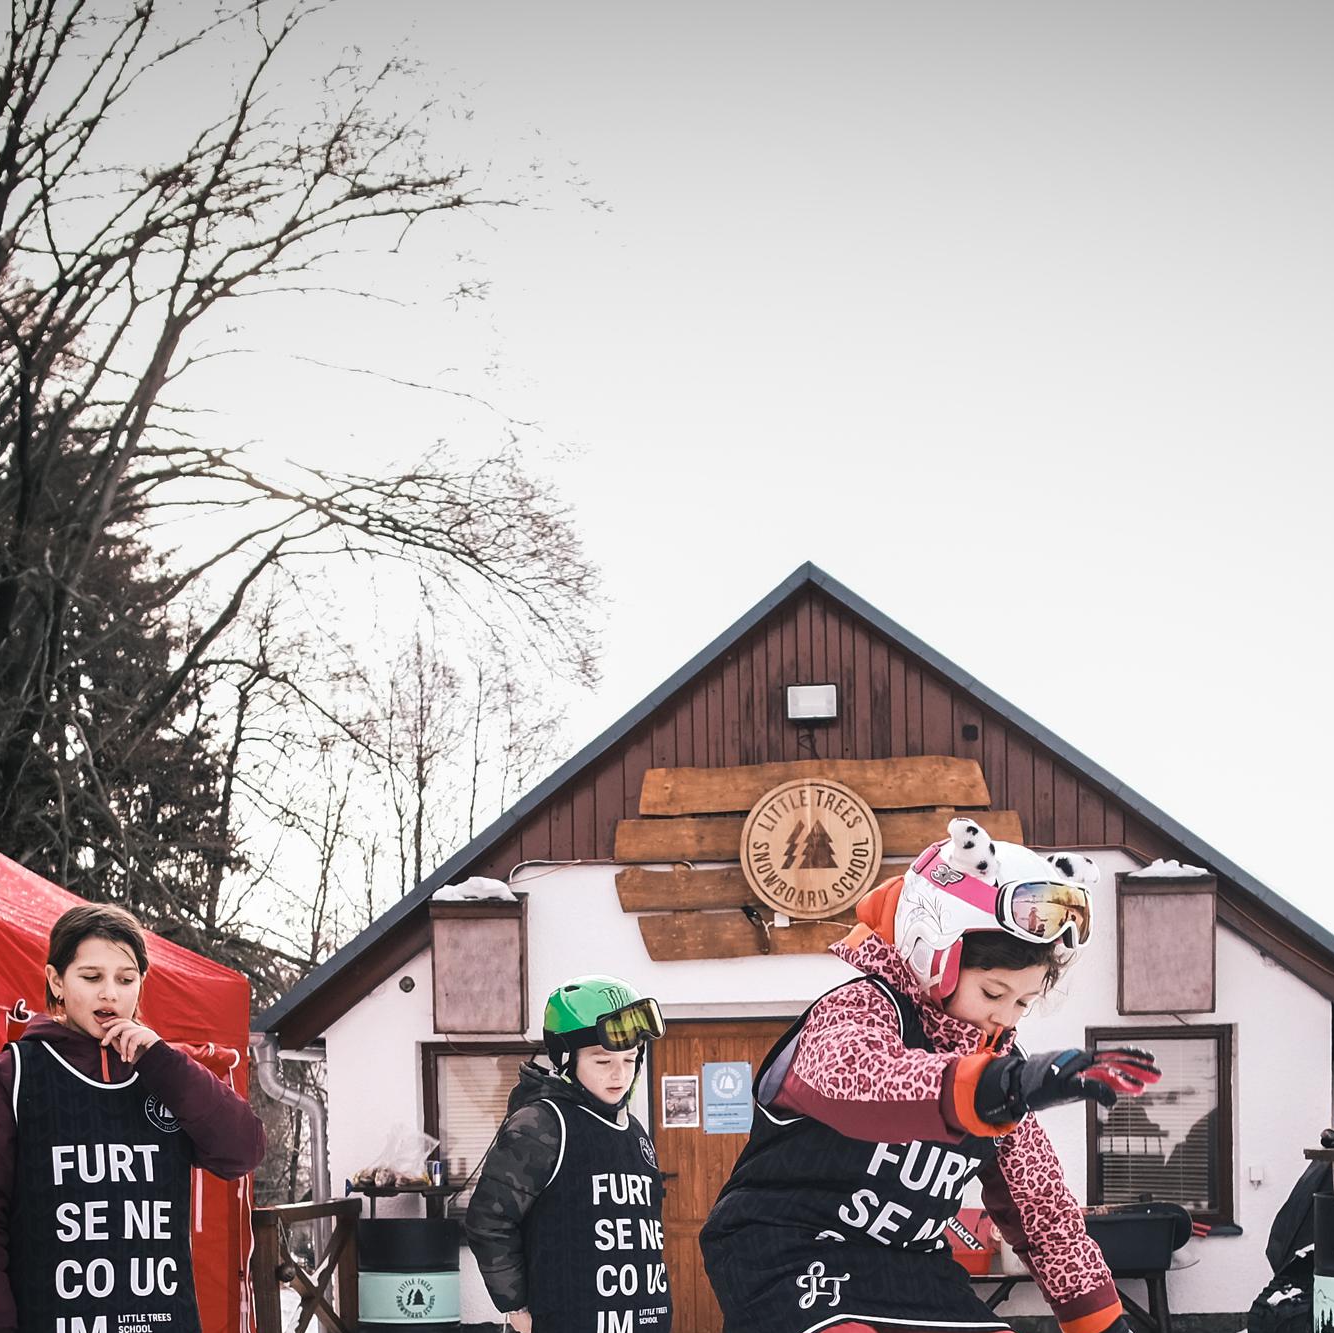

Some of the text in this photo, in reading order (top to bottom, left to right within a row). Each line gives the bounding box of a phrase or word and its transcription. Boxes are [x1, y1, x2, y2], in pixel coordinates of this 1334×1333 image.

[757, 789, 863, 833] LITTLE TREES
[752, 836, 870, 908] SNOWBOARD SCHOOL
[51, 1143, 160, 1185] FURT
[591, 1173, 653, 1207] FURT
[55, 1199, 172, 1242] SE NE
[594, 1218, 633, 1251] SE
[837, 1188, 913, 1245] SE
[55, 1256, 178, 1300] CO UC
[596, 1263, 638, 1297] CO
[117, 1313, 172, 1323] LITTLE TREES
[118, 1324, 153, 1333] SCHOOL
